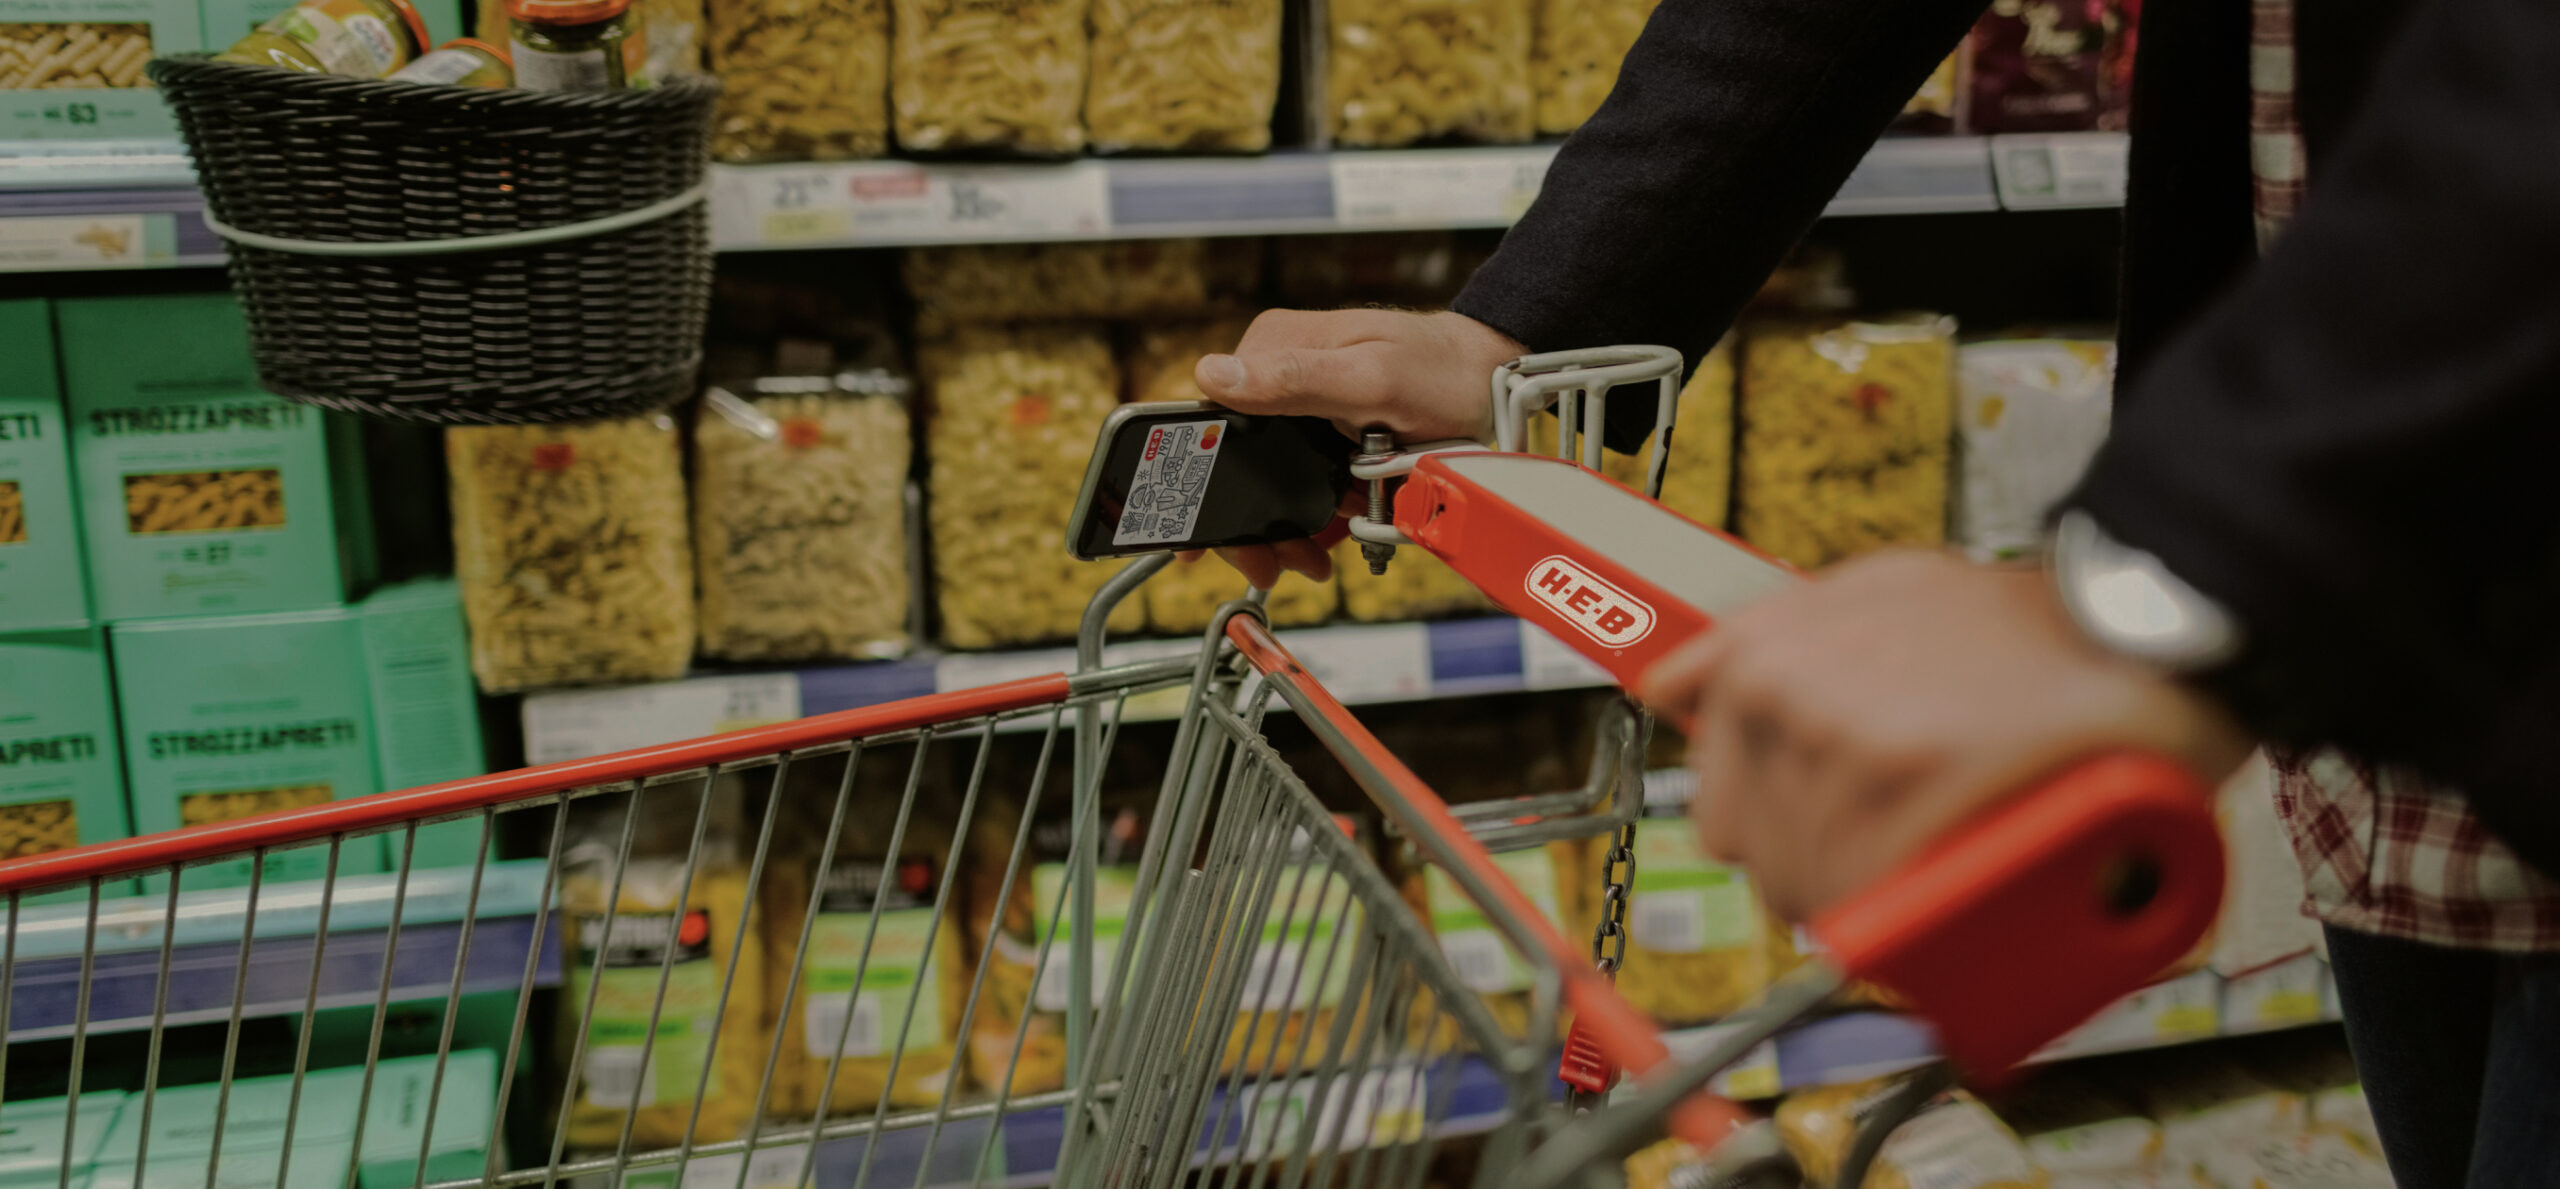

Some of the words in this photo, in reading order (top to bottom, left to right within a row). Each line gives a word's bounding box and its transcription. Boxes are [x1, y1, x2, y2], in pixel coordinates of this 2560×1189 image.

[89, 402, 306, 438] STROZZAPRETI
[1157, 431, 1173, 456] 1905
[149, 721, 356, 759] STROZZAPRETI
